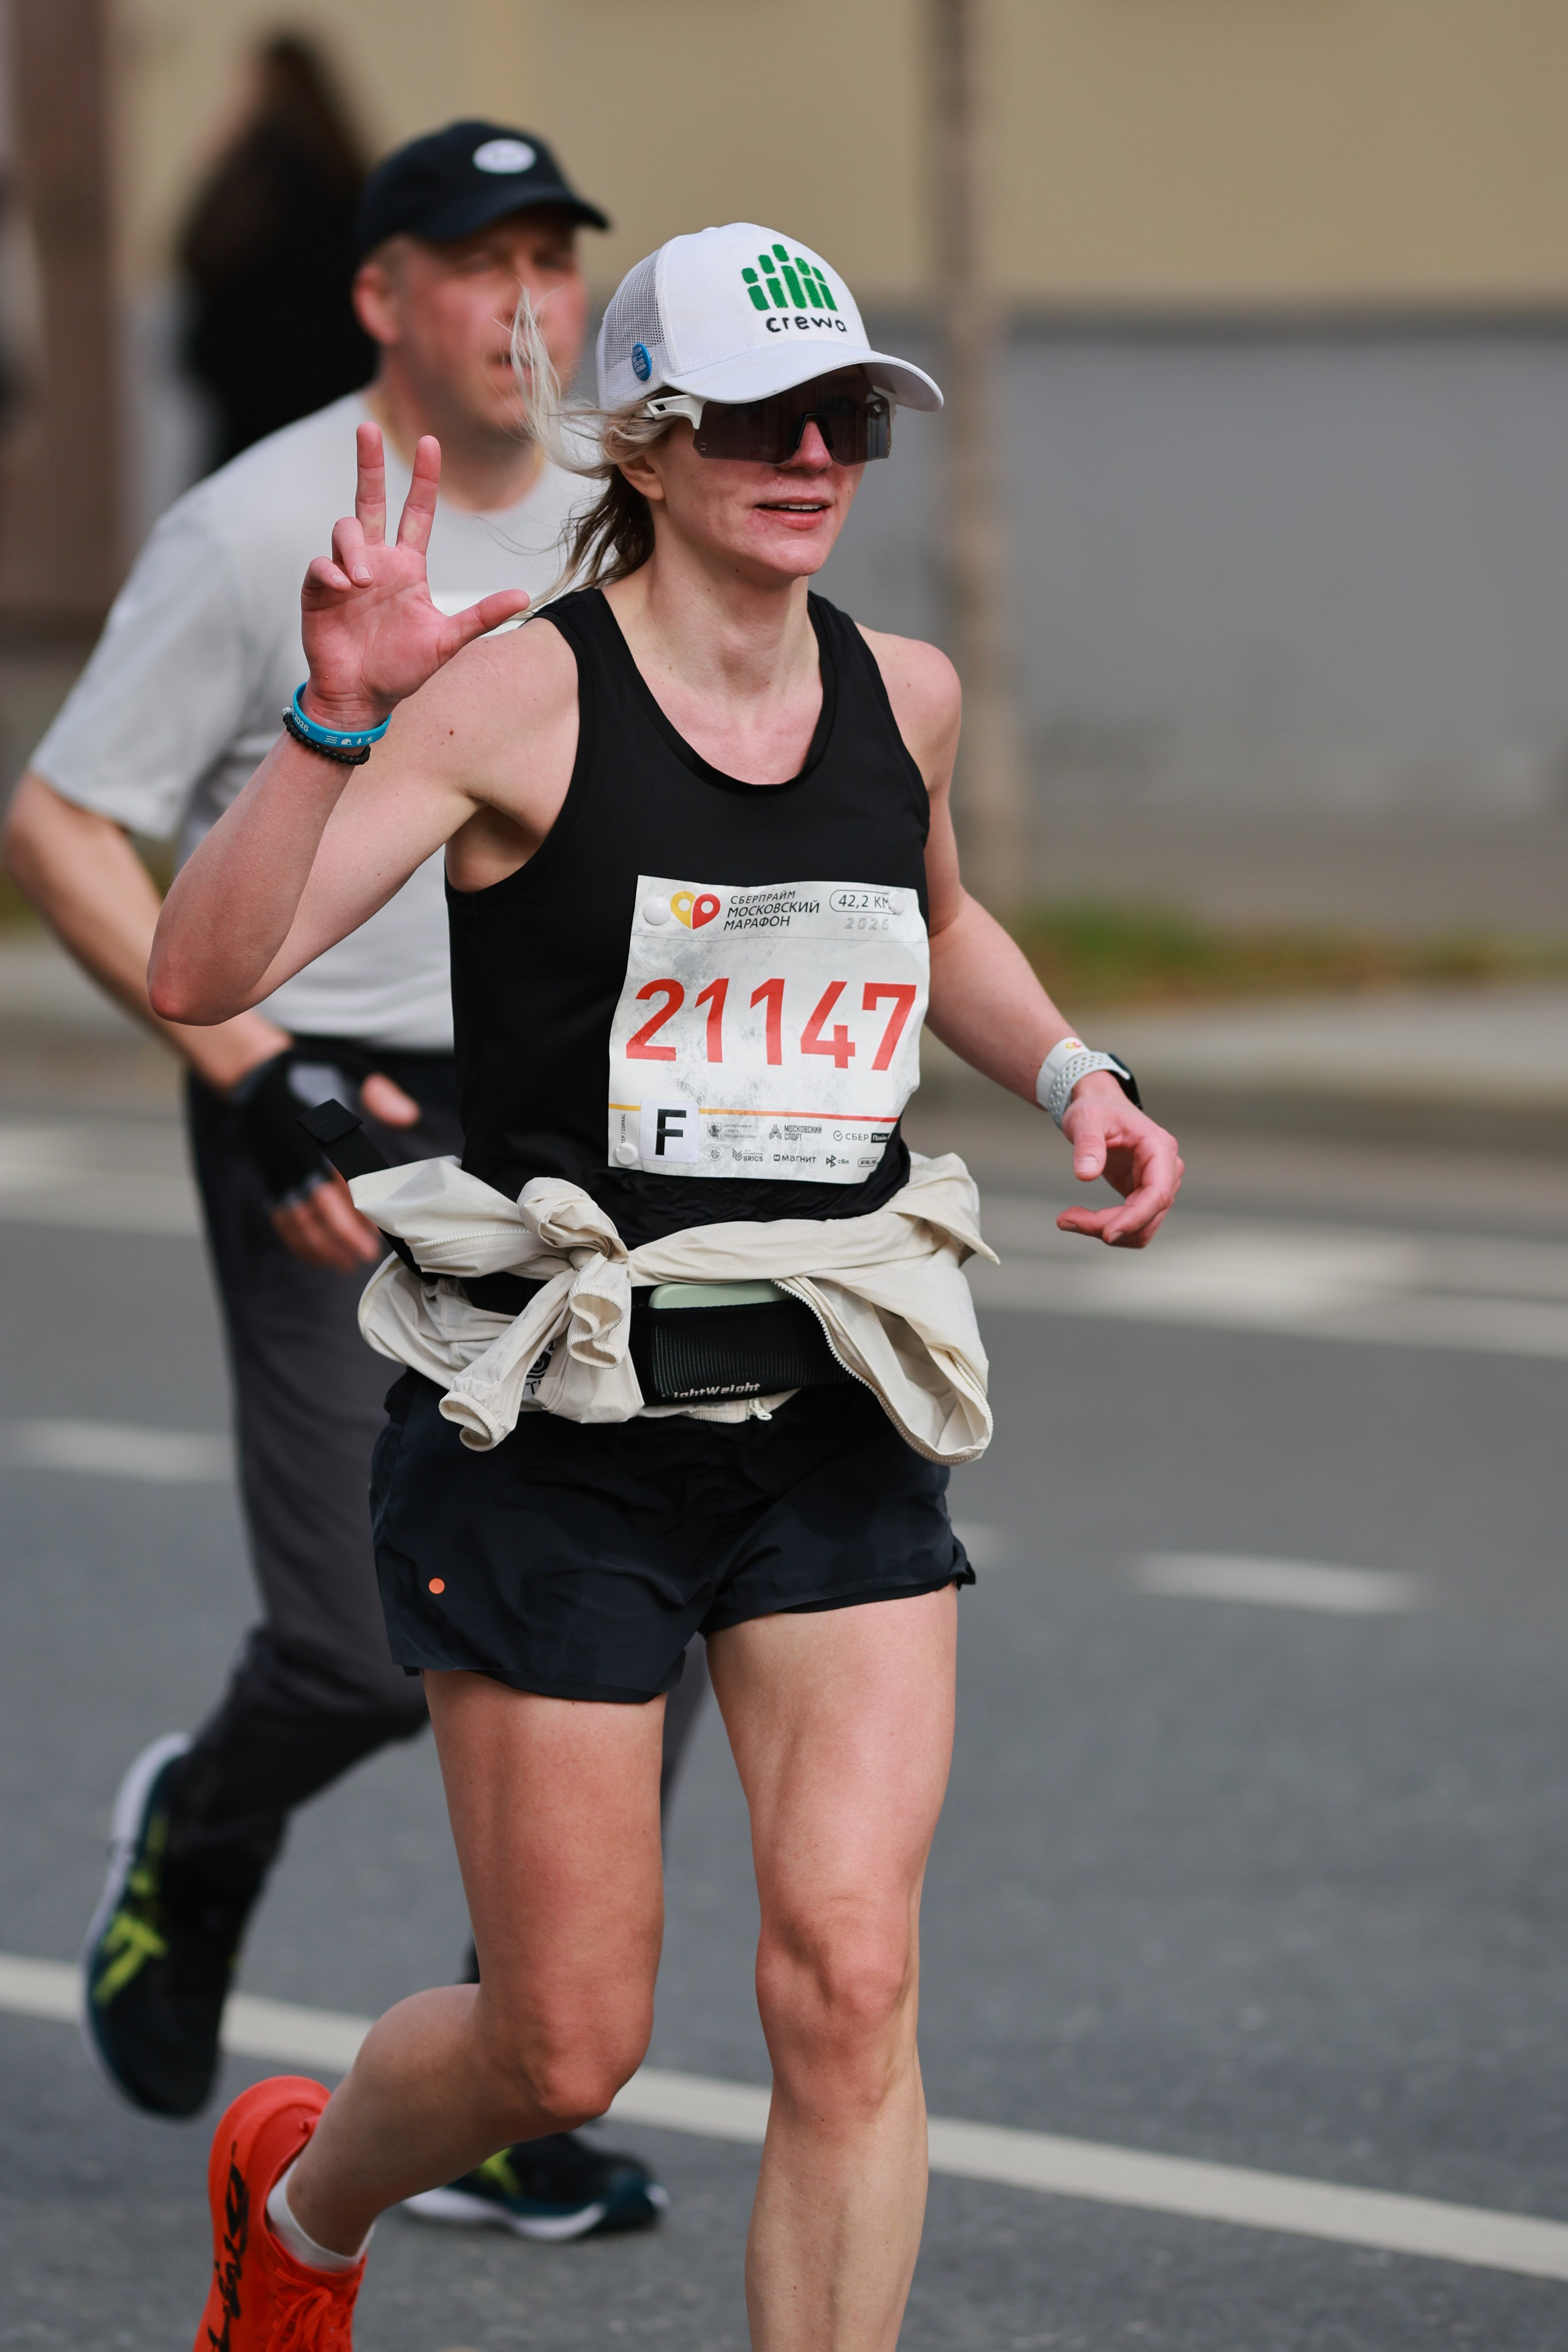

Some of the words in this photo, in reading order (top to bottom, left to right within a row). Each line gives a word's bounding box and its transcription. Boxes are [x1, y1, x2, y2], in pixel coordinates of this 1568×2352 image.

[766, 316, 847, 333] crewa
[294, 713, 309, 732] 2026
[731, 890, 796, 904] СБЕРПРАЙМ
[839, 895, 869, 909] 42,2
[727, 900, 820, 918] МОСКОВСКИЙ
[723, 916, 790, 930] МАРАФОН
[845, 918, 888, 930] 2026
[625, 978, 917, 1071] 21147
[655, 1109, 687, 1156] F
[784, 1125, 822, 1134] МОСКОВСКИЙ
